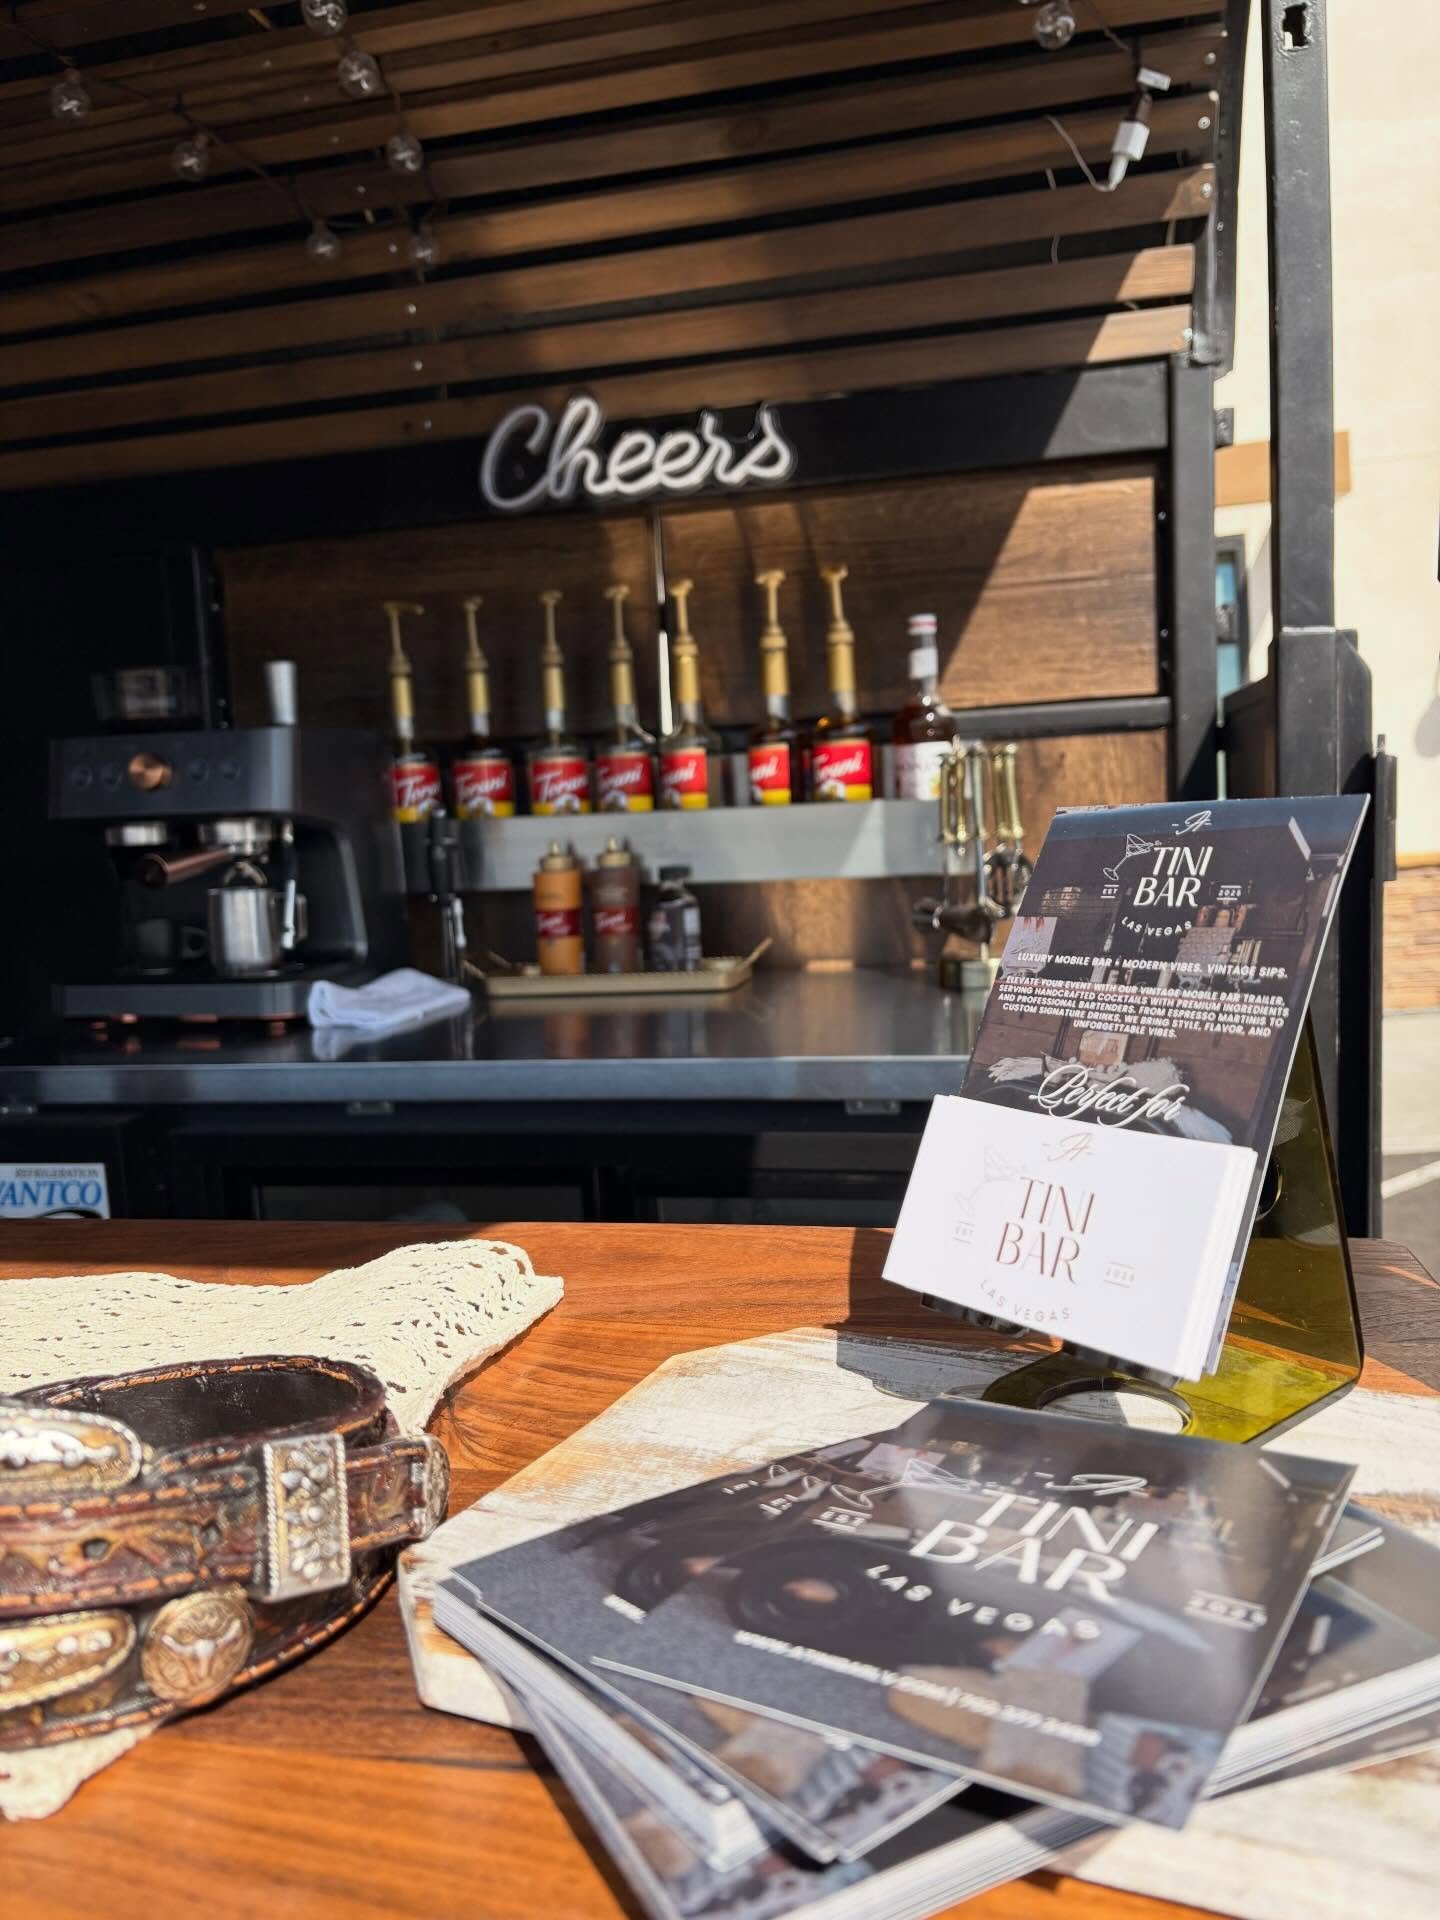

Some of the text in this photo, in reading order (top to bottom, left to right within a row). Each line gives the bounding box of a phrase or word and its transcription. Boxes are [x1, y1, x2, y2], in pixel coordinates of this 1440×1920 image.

[481, 396, 791, 510] Cheers
[1152, 846, 1214, 876] TINI
[1102, 888, 1119, 896] EST
[1132, 877, 1202, 907] BAR
[1121, 916, 1193, 938] LAS VEGAS
[1018, 952, 1053, 963] LUXURY
[1055, 955, 1090, 966] MOBILE
[1092, 957, 1112, 967] BAR
[1122, 959, 1168, 971] MODERN
[1207, 964, 1257, 977] VINTAGE
[1259, 966, 1288, 979] SIPS.
[999, 984, 1290, 1018] SERVING HANDCRAFTED COCKTAILS WITH PREMIUM INGREDIENTS
[1006, 975, 1040, 986] ELEVATE
[1041, 978, 1065, 988] YOUR
[1065, 980, 1091, 990] EVENT
[1094, 983, 1116, 992] WITH
[1118, 985, 1138, 994] OUR
[1140, 987, 1181, 998] VINTAGE
[1182, 989, 1219, 1001] MOBILE
[1220, 992, 1241, 1002] BAR
[998, 994, 1016, 1002] AND
[1017, 996, 1077, 1008] PROFESSIONAL
[1139, 1006, 1166, 1017] FROM
[1167, 1009, 1217, 1021] ESPRESSO
[1218, 1013, 1267, 1026] MARTINIS
[1270, 1017, 1284, 1028] TO
[1003, 1002, 1038, 1014] CUSTOM
[1039, 1006, 1085, 1019] SIGNATURE
[1125, 1014, 1139, 1024] WE
[1140, 1016, 1170, 1027] BRING
[1247, 1027, 1271, 1038] AND
[1073, 1020, 1146, 1035] UNFORGETTABLE
[1030, 1064, 1190, 1127] Perfect for
[1019, 1176, 1095, 1235] TINI
[996, 1221, 1081, 1286] BAR
[979, 1279, 1070, 1323] LAS VEGAS
[976, 1487, 1160, 1562] TINI
[909, 1519, 1127, 1602] BAR
[864, 1564, 1101, 1641] LAS VEGAS
